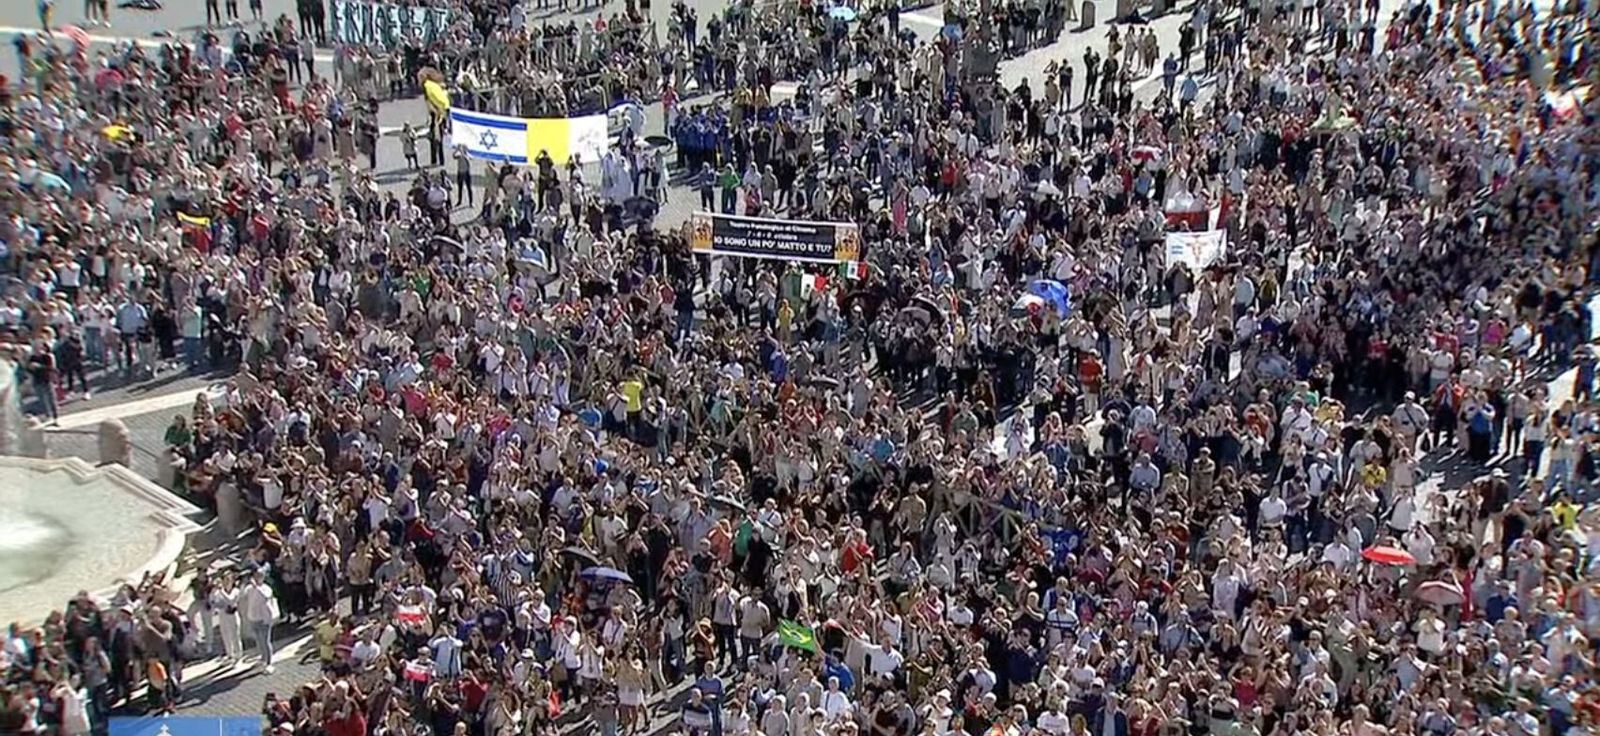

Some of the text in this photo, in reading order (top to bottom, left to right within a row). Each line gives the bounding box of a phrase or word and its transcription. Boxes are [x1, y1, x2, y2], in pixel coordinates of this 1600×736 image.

[714, 236, 723, 244] IO
[724, 237, 747, 246] SONO
[748, 239, 761, 247] UN
[777, 241, 807, 251] MATTO
[808, 243, 814, 251] E
[815, 244, 832, 253] TU?
